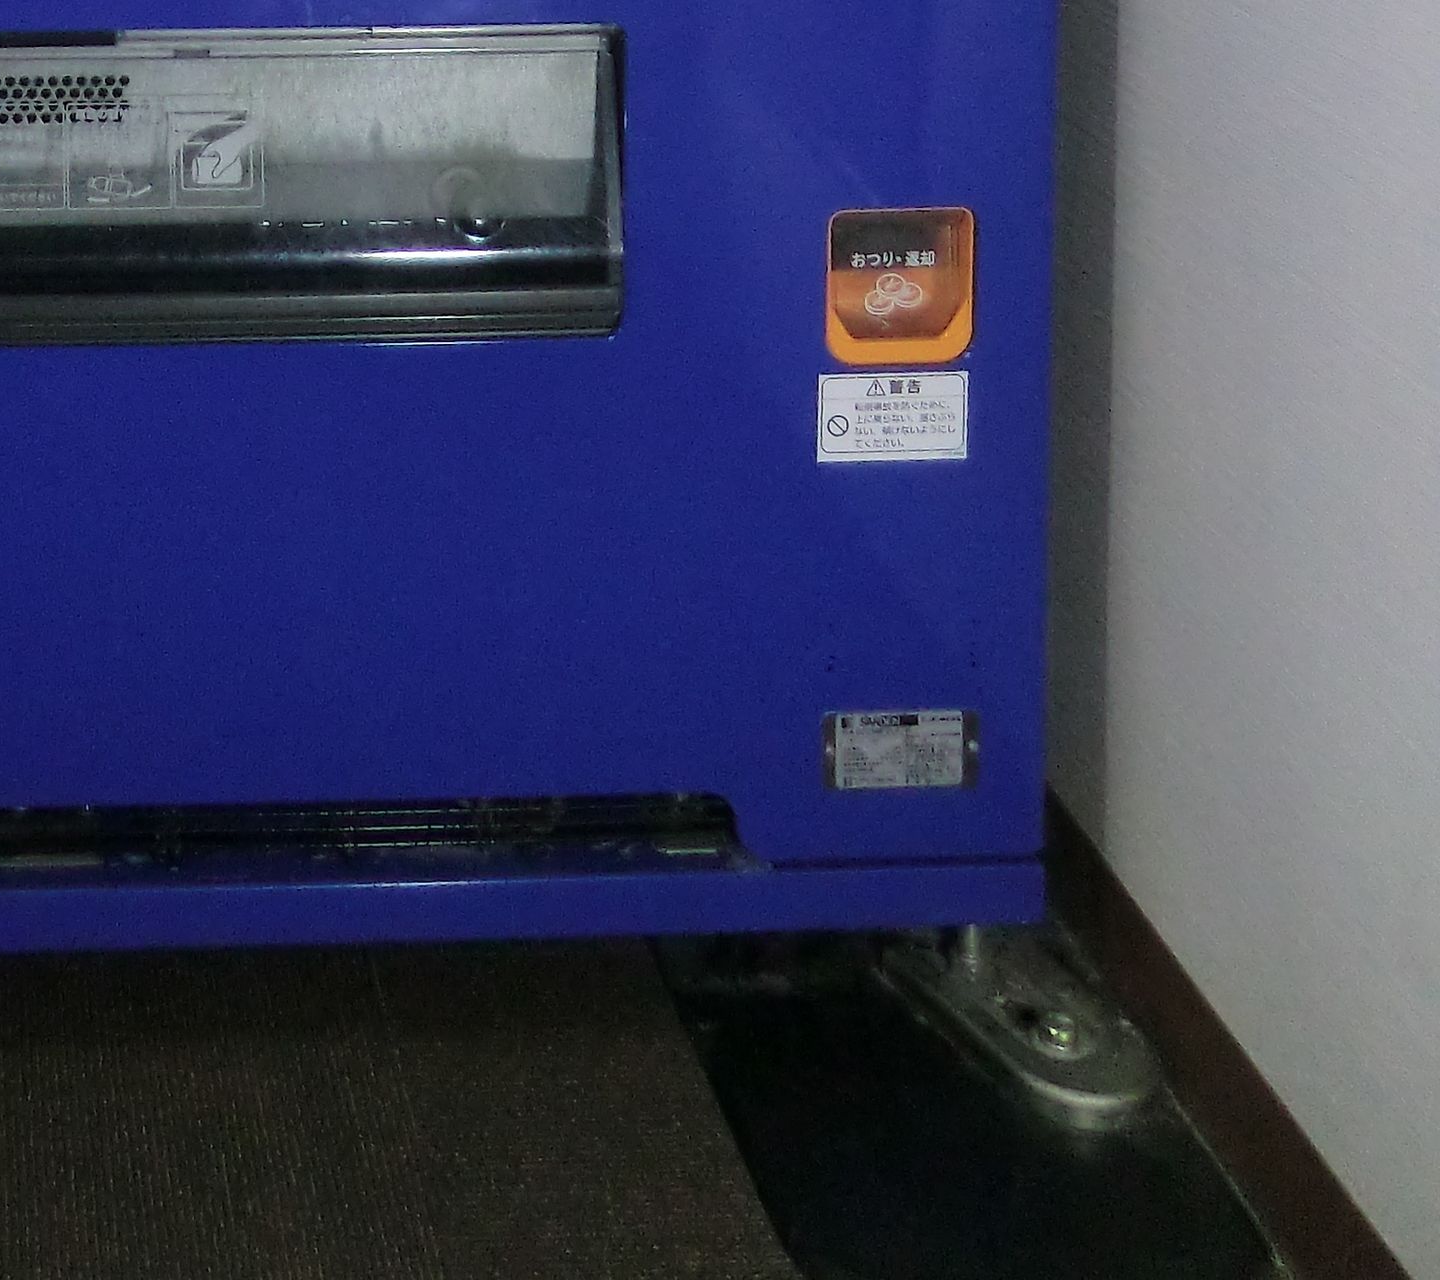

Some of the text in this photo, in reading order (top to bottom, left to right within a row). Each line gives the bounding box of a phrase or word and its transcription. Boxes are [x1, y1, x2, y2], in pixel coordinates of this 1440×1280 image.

[849, 249, 937, 269] おつり・返却
[888, 378, 922, 395] 警告
